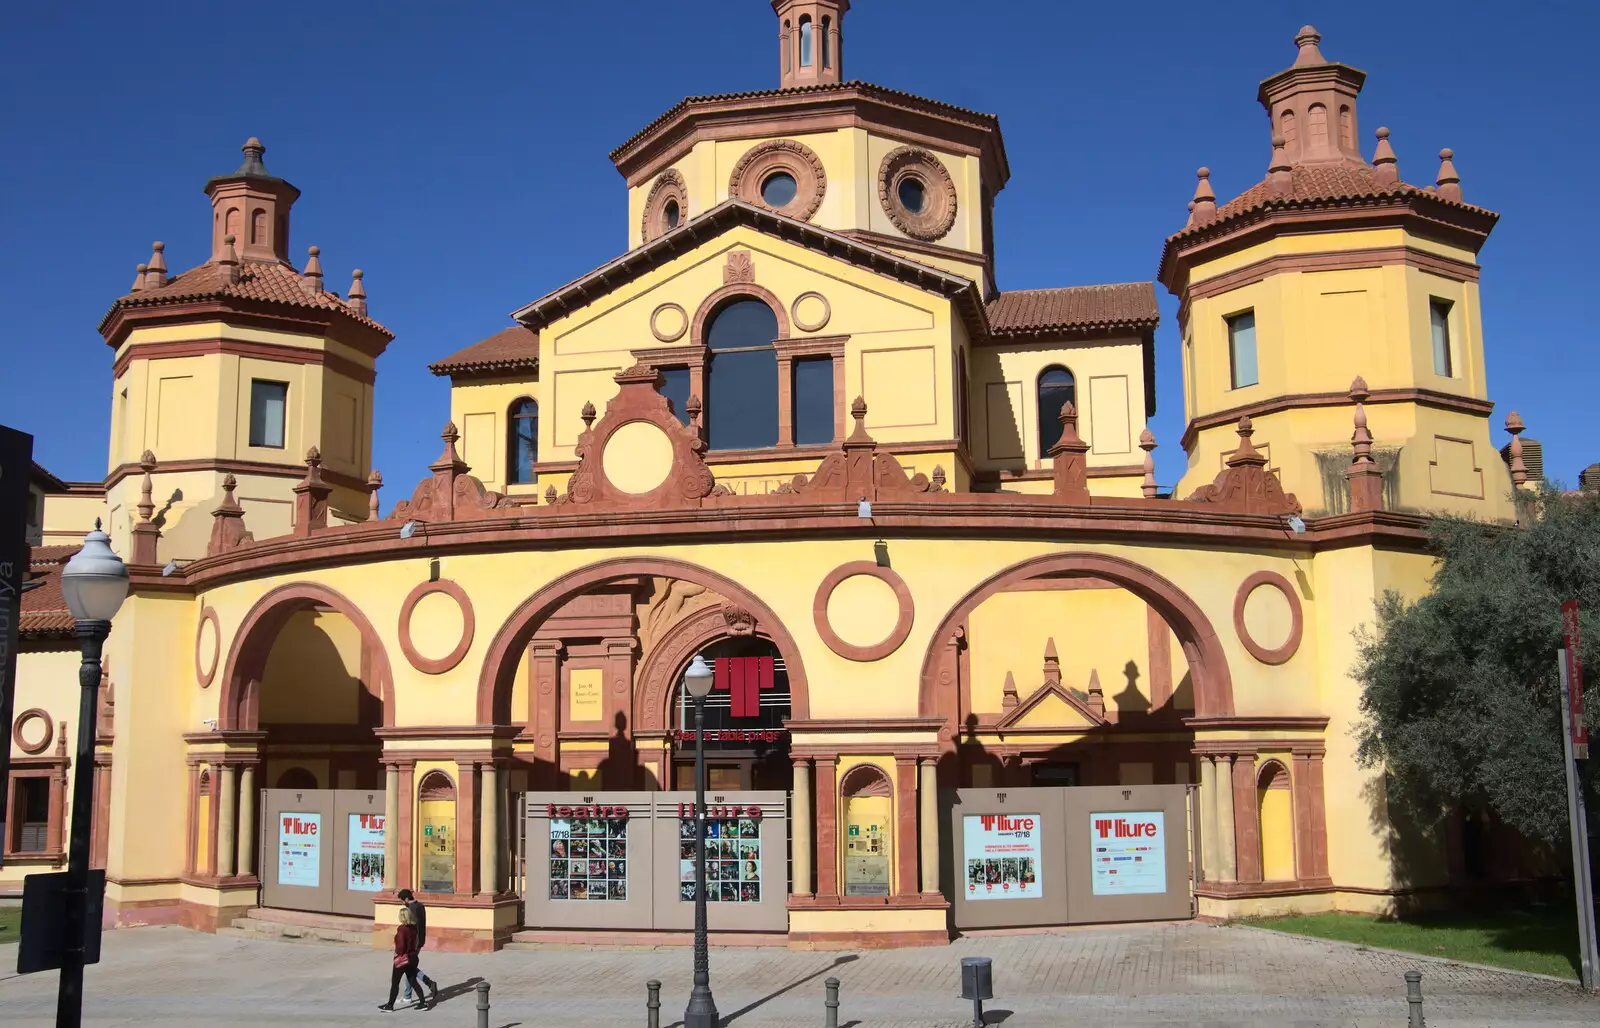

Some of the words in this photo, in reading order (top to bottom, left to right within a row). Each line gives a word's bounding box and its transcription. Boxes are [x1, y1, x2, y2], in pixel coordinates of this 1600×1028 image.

[546, 802, 627, 818] teatre
[678, 802, 761, 818] llure
[369, 814, 385, 830] lliur
[551, 830, 570, 839] 17/18
